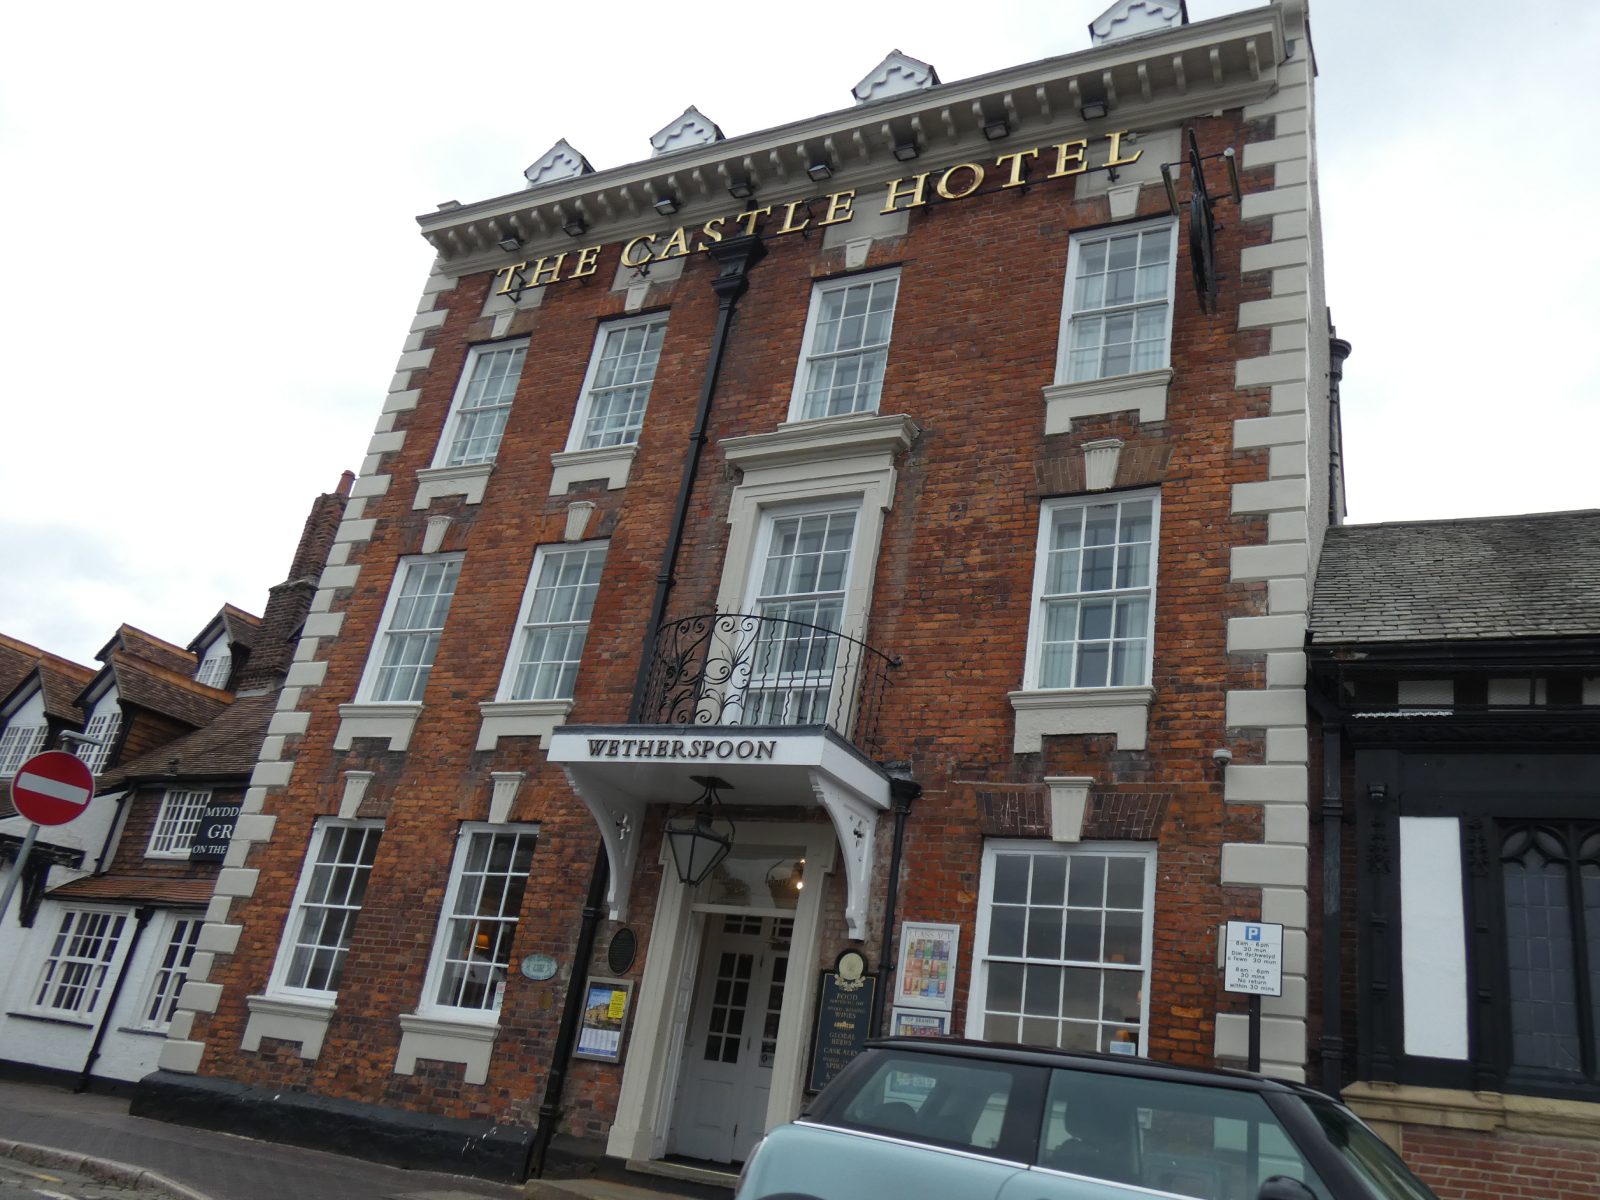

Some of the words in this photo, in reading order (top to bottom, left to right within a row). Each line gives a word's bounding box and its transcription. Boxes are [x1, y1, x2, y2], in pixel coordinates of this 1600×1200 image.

[496, 245, 602, 295] THE
[620, 189, 856, 267] CASTLE
[880, 130, 1144, 215] HOTEL
[587, 739, 776, 760] WETHERSPOON
[205, 806, 240, 817] MYDD
[192, 845, 207, 854] ON
[208, 845, 228, 854] THE
